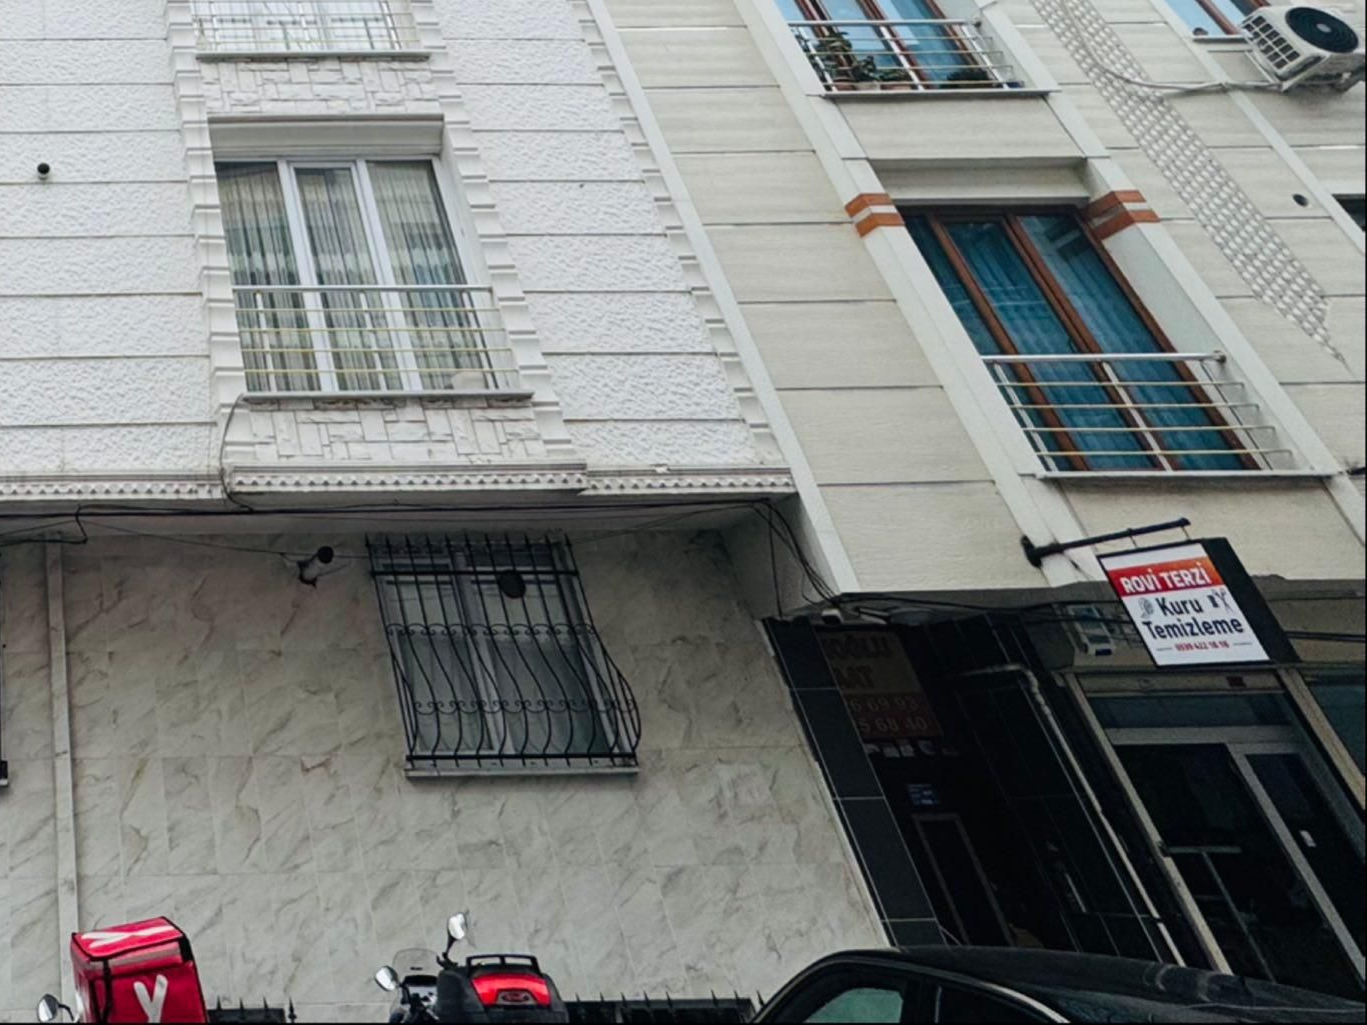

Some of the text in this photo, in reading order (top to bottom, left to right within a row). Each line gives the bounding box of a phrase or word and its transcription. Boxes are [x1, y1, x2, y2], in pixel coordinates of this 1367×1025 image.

[1159, 562, 1212, 589] TERZİ
[1155, 593, 1204, 617] Kuru
[1142, 617, 1245, 641] Temizleme
